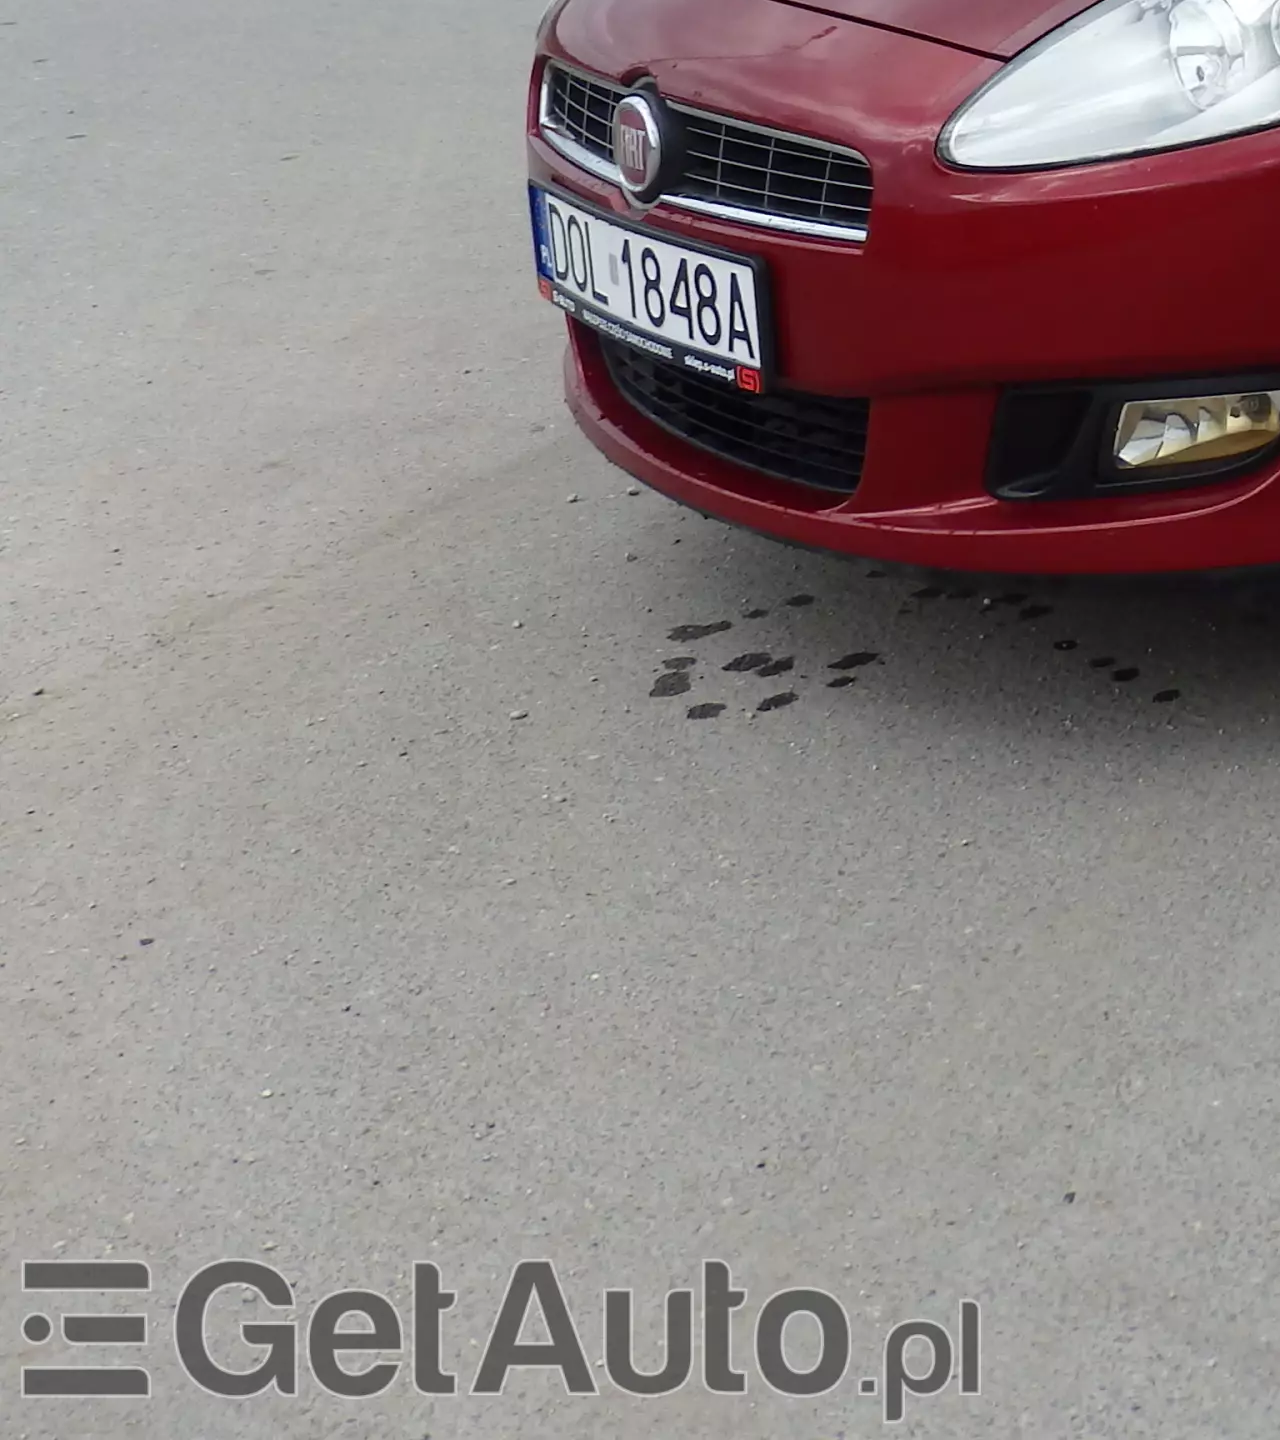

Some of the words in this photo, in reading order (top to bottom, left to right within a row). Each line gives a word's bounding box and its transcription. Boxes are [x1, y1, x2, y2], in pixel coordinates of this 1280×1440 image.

[620, 123, 647, 172] FIAT
[548, 201, 609, 306] DOL
[621, 238, 756, 360] 1848A
